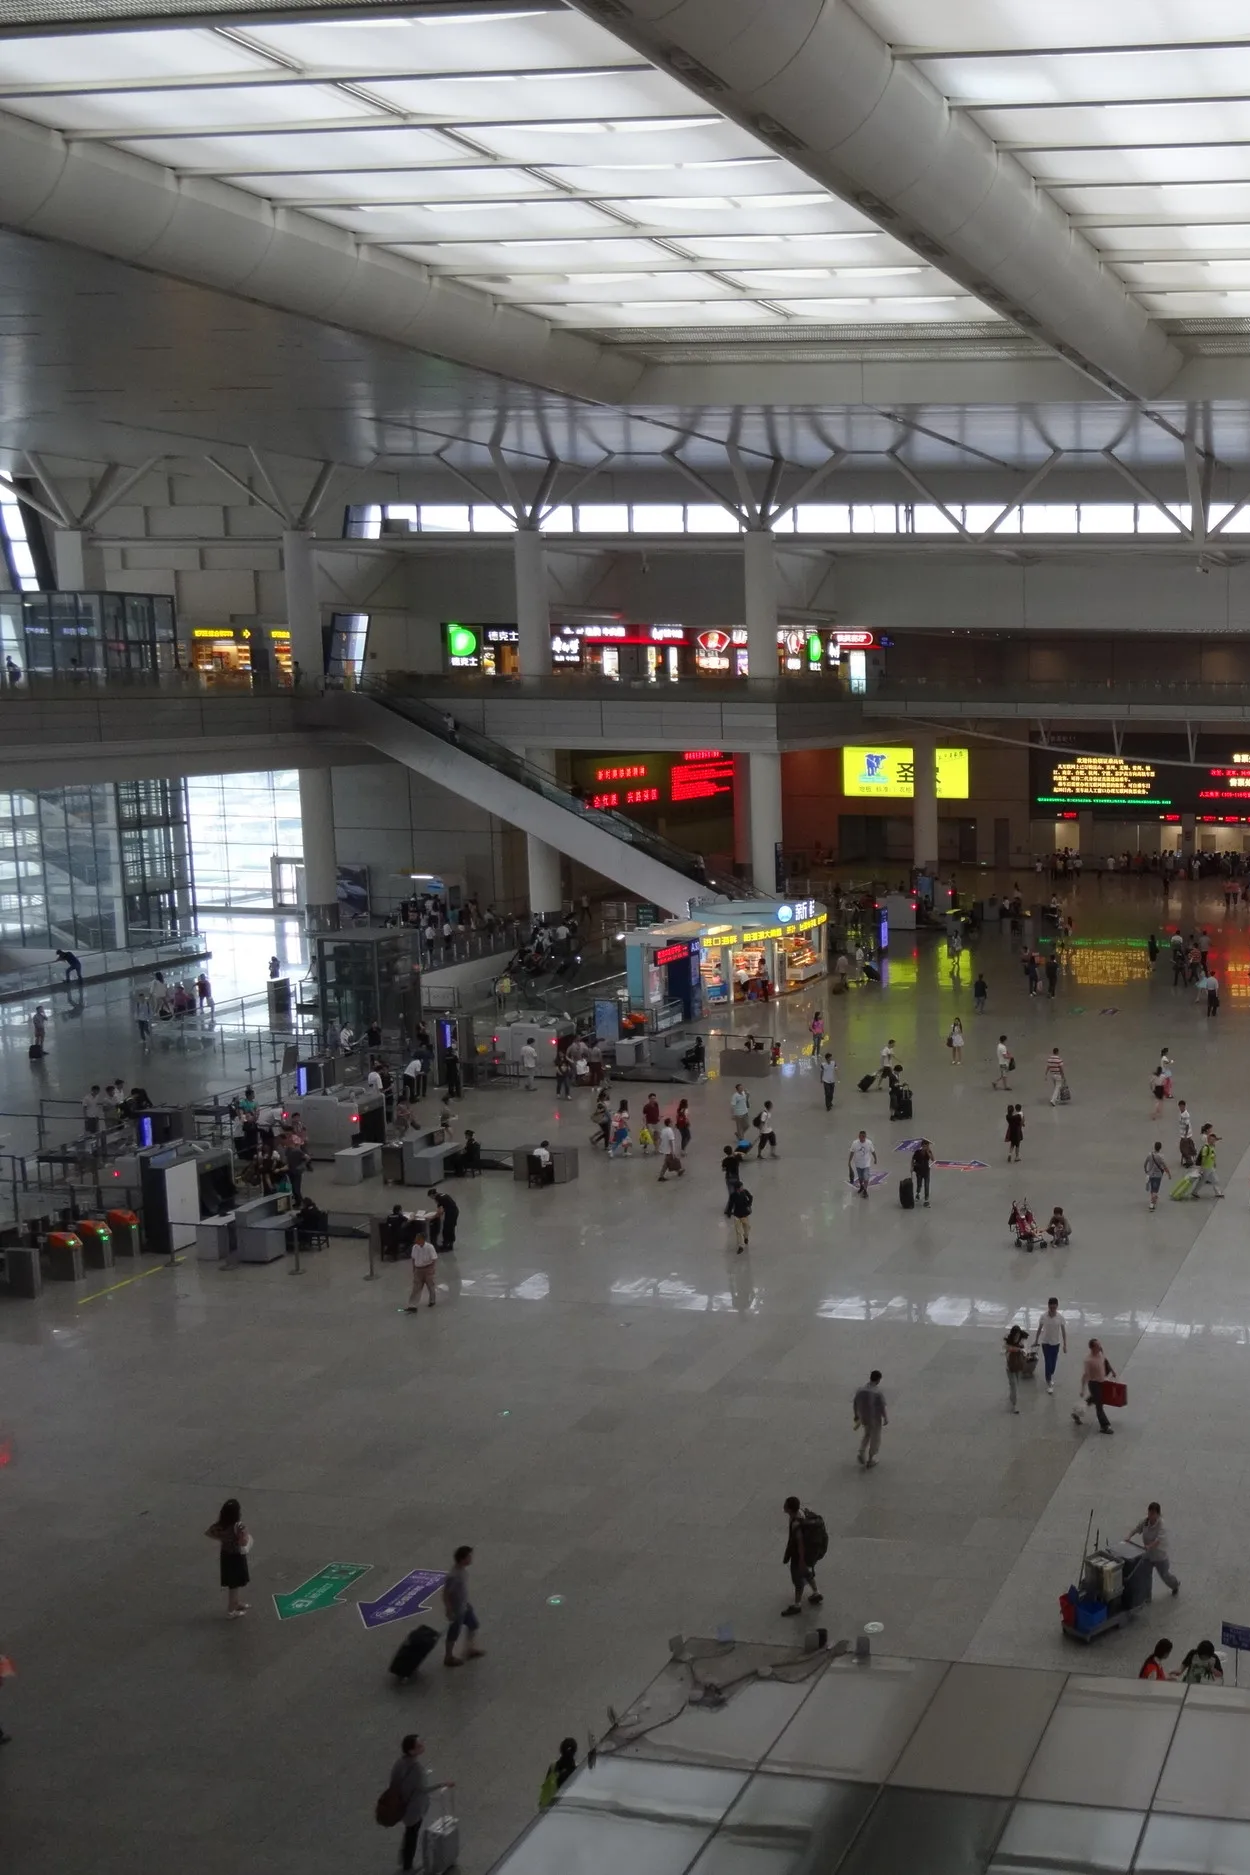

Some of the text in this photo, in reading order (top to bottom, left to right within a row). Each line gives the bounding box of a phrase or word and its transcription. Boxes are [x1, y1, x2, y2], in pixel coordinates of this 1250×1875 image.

[488, 631, 518, 641] 德克士
[451, 657, 478, 666] 德克士
